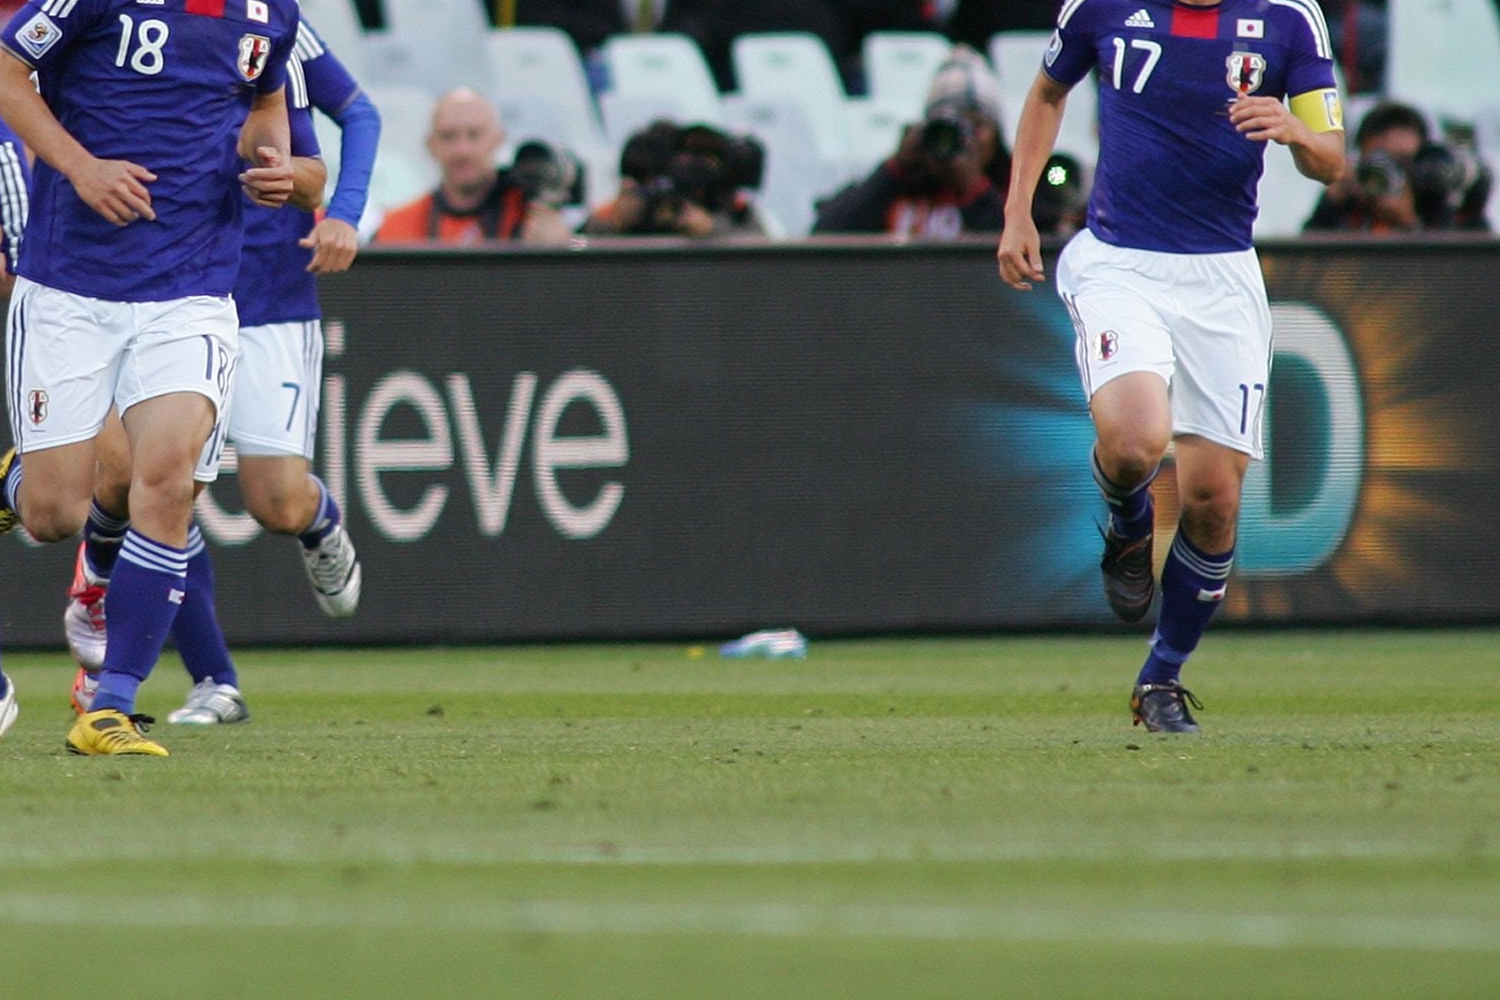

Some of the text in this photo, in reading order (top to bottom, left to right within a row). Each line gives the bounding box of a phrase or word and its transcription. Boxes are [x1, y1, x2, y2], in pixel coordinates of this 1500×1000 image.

[115, 13, 170, 76] 18
[1112, 36, 1163, 94] 17
[282, 382, 301, 433] 7
